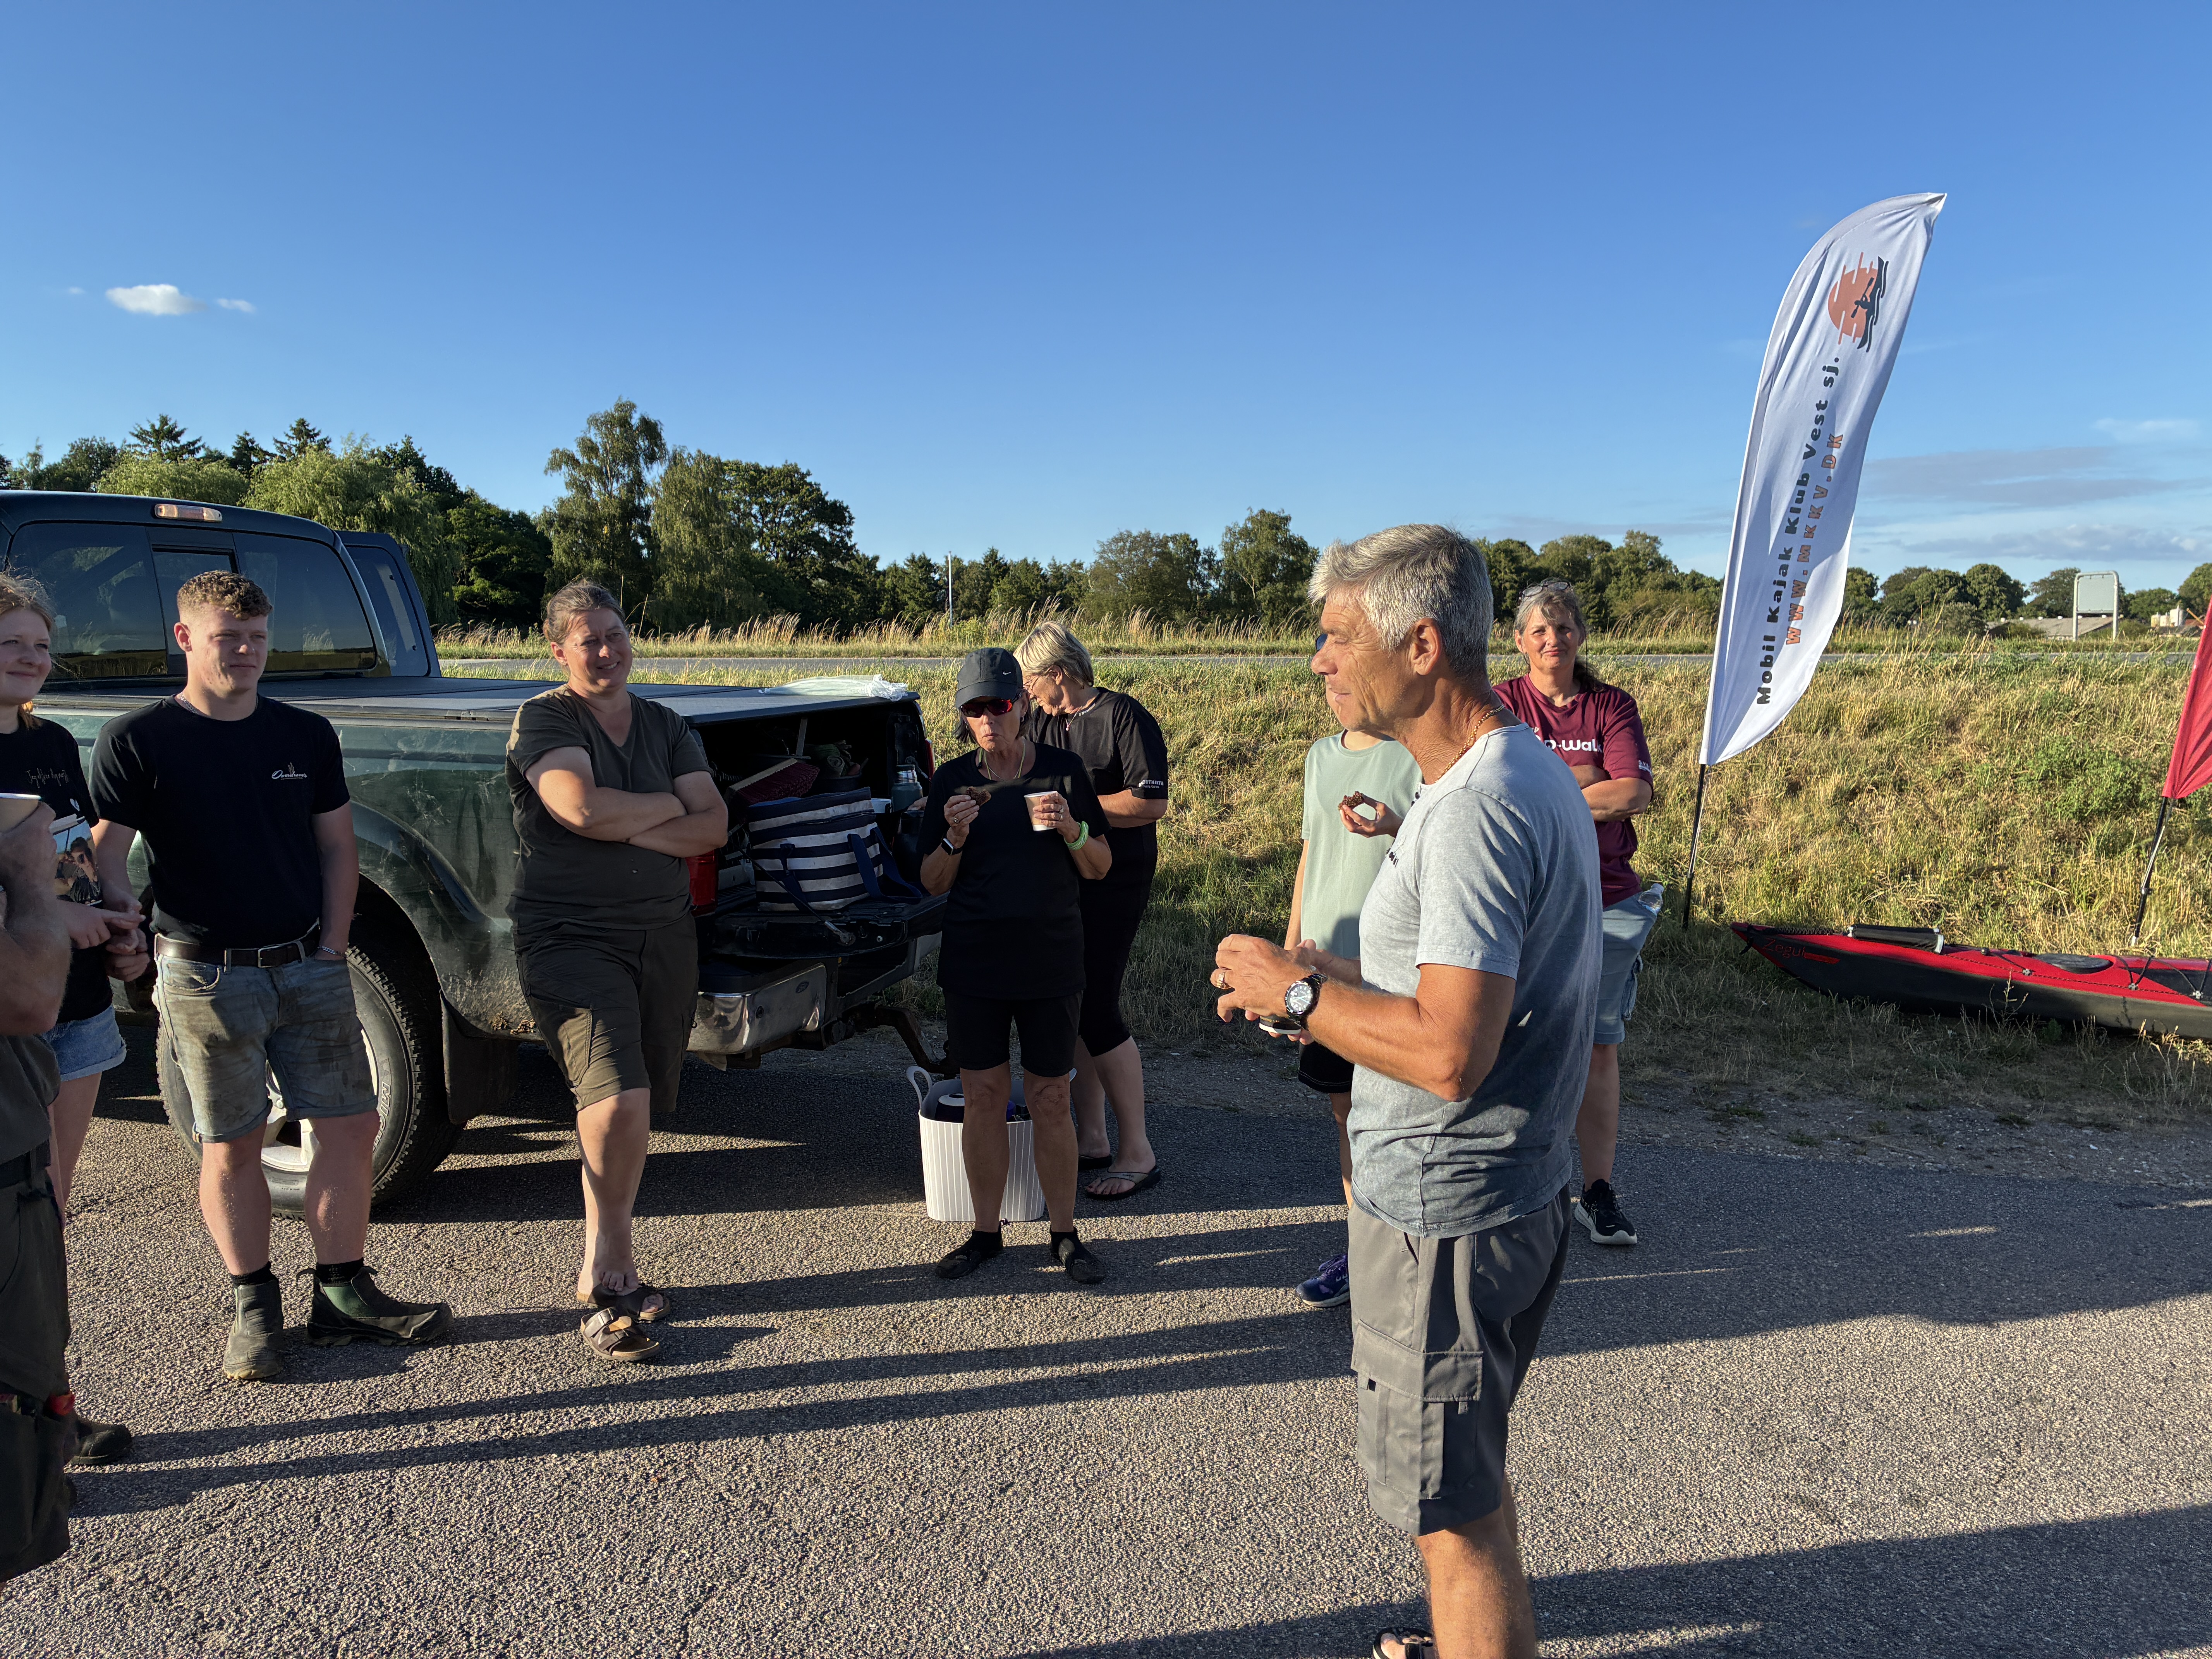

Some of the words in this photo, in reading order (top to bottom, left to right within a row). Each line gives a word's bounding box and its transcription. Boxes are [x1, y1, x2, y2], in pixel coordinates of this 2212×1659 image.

[1757, 635, 1776, 704] Mobil
[1767, 547, 1793, 623] Kajak
[1785, 473, 1810, 534] Klub
[1803, 400, 1828, 460] Vest
[1822, 357, 1839, 388] sj.
[1762, 937, 1805, 958] Zegul
